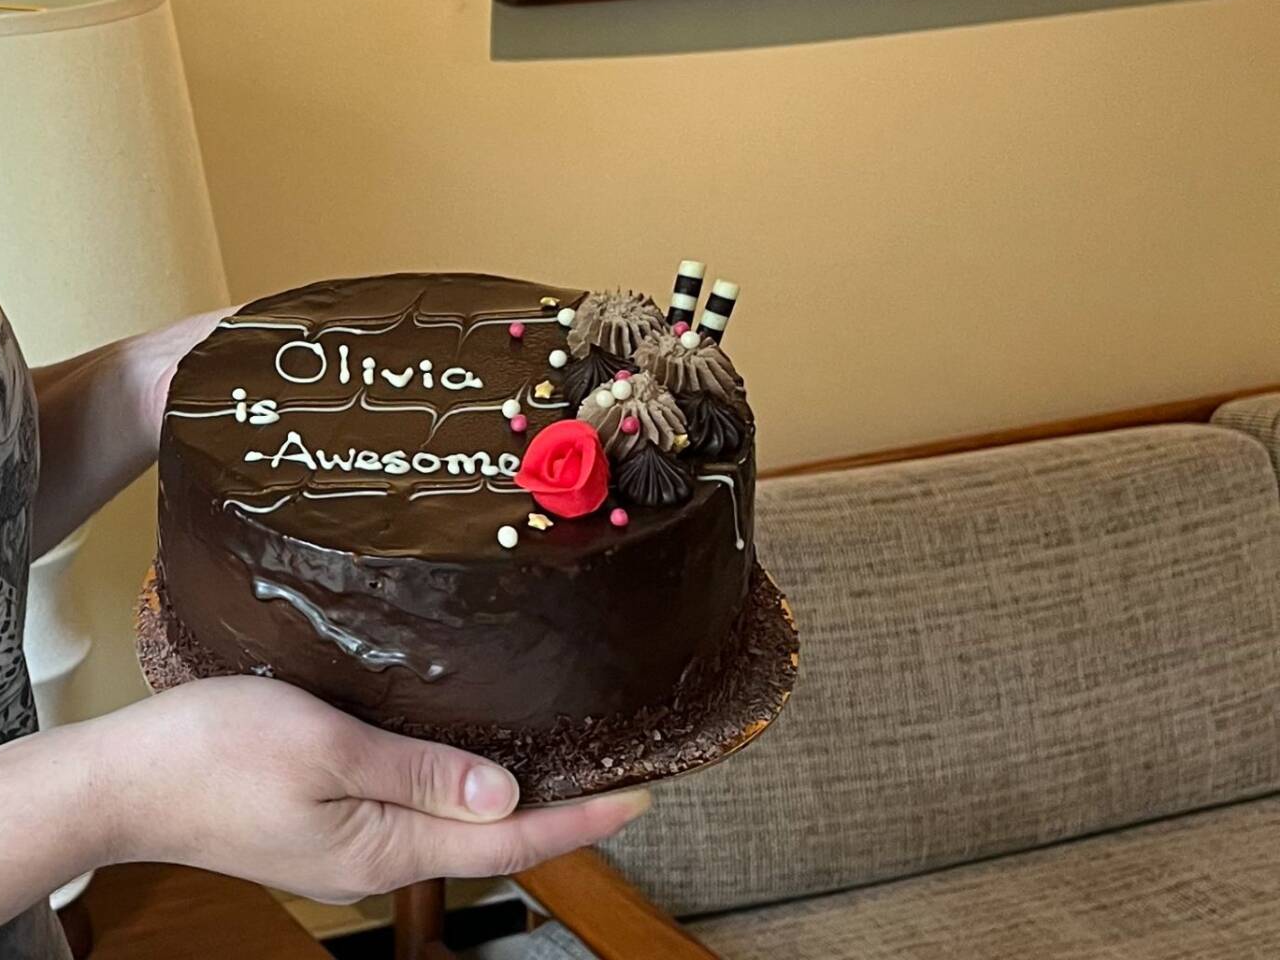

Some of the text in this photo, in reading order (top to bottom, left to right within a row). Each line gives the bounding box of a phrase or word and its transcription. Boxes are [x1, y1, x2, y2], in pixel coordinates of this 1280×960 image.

[275, 341, 483, 389] Olivia
[232, 388, 280, 424] is
[245, 431, 521, 476] Awesome
